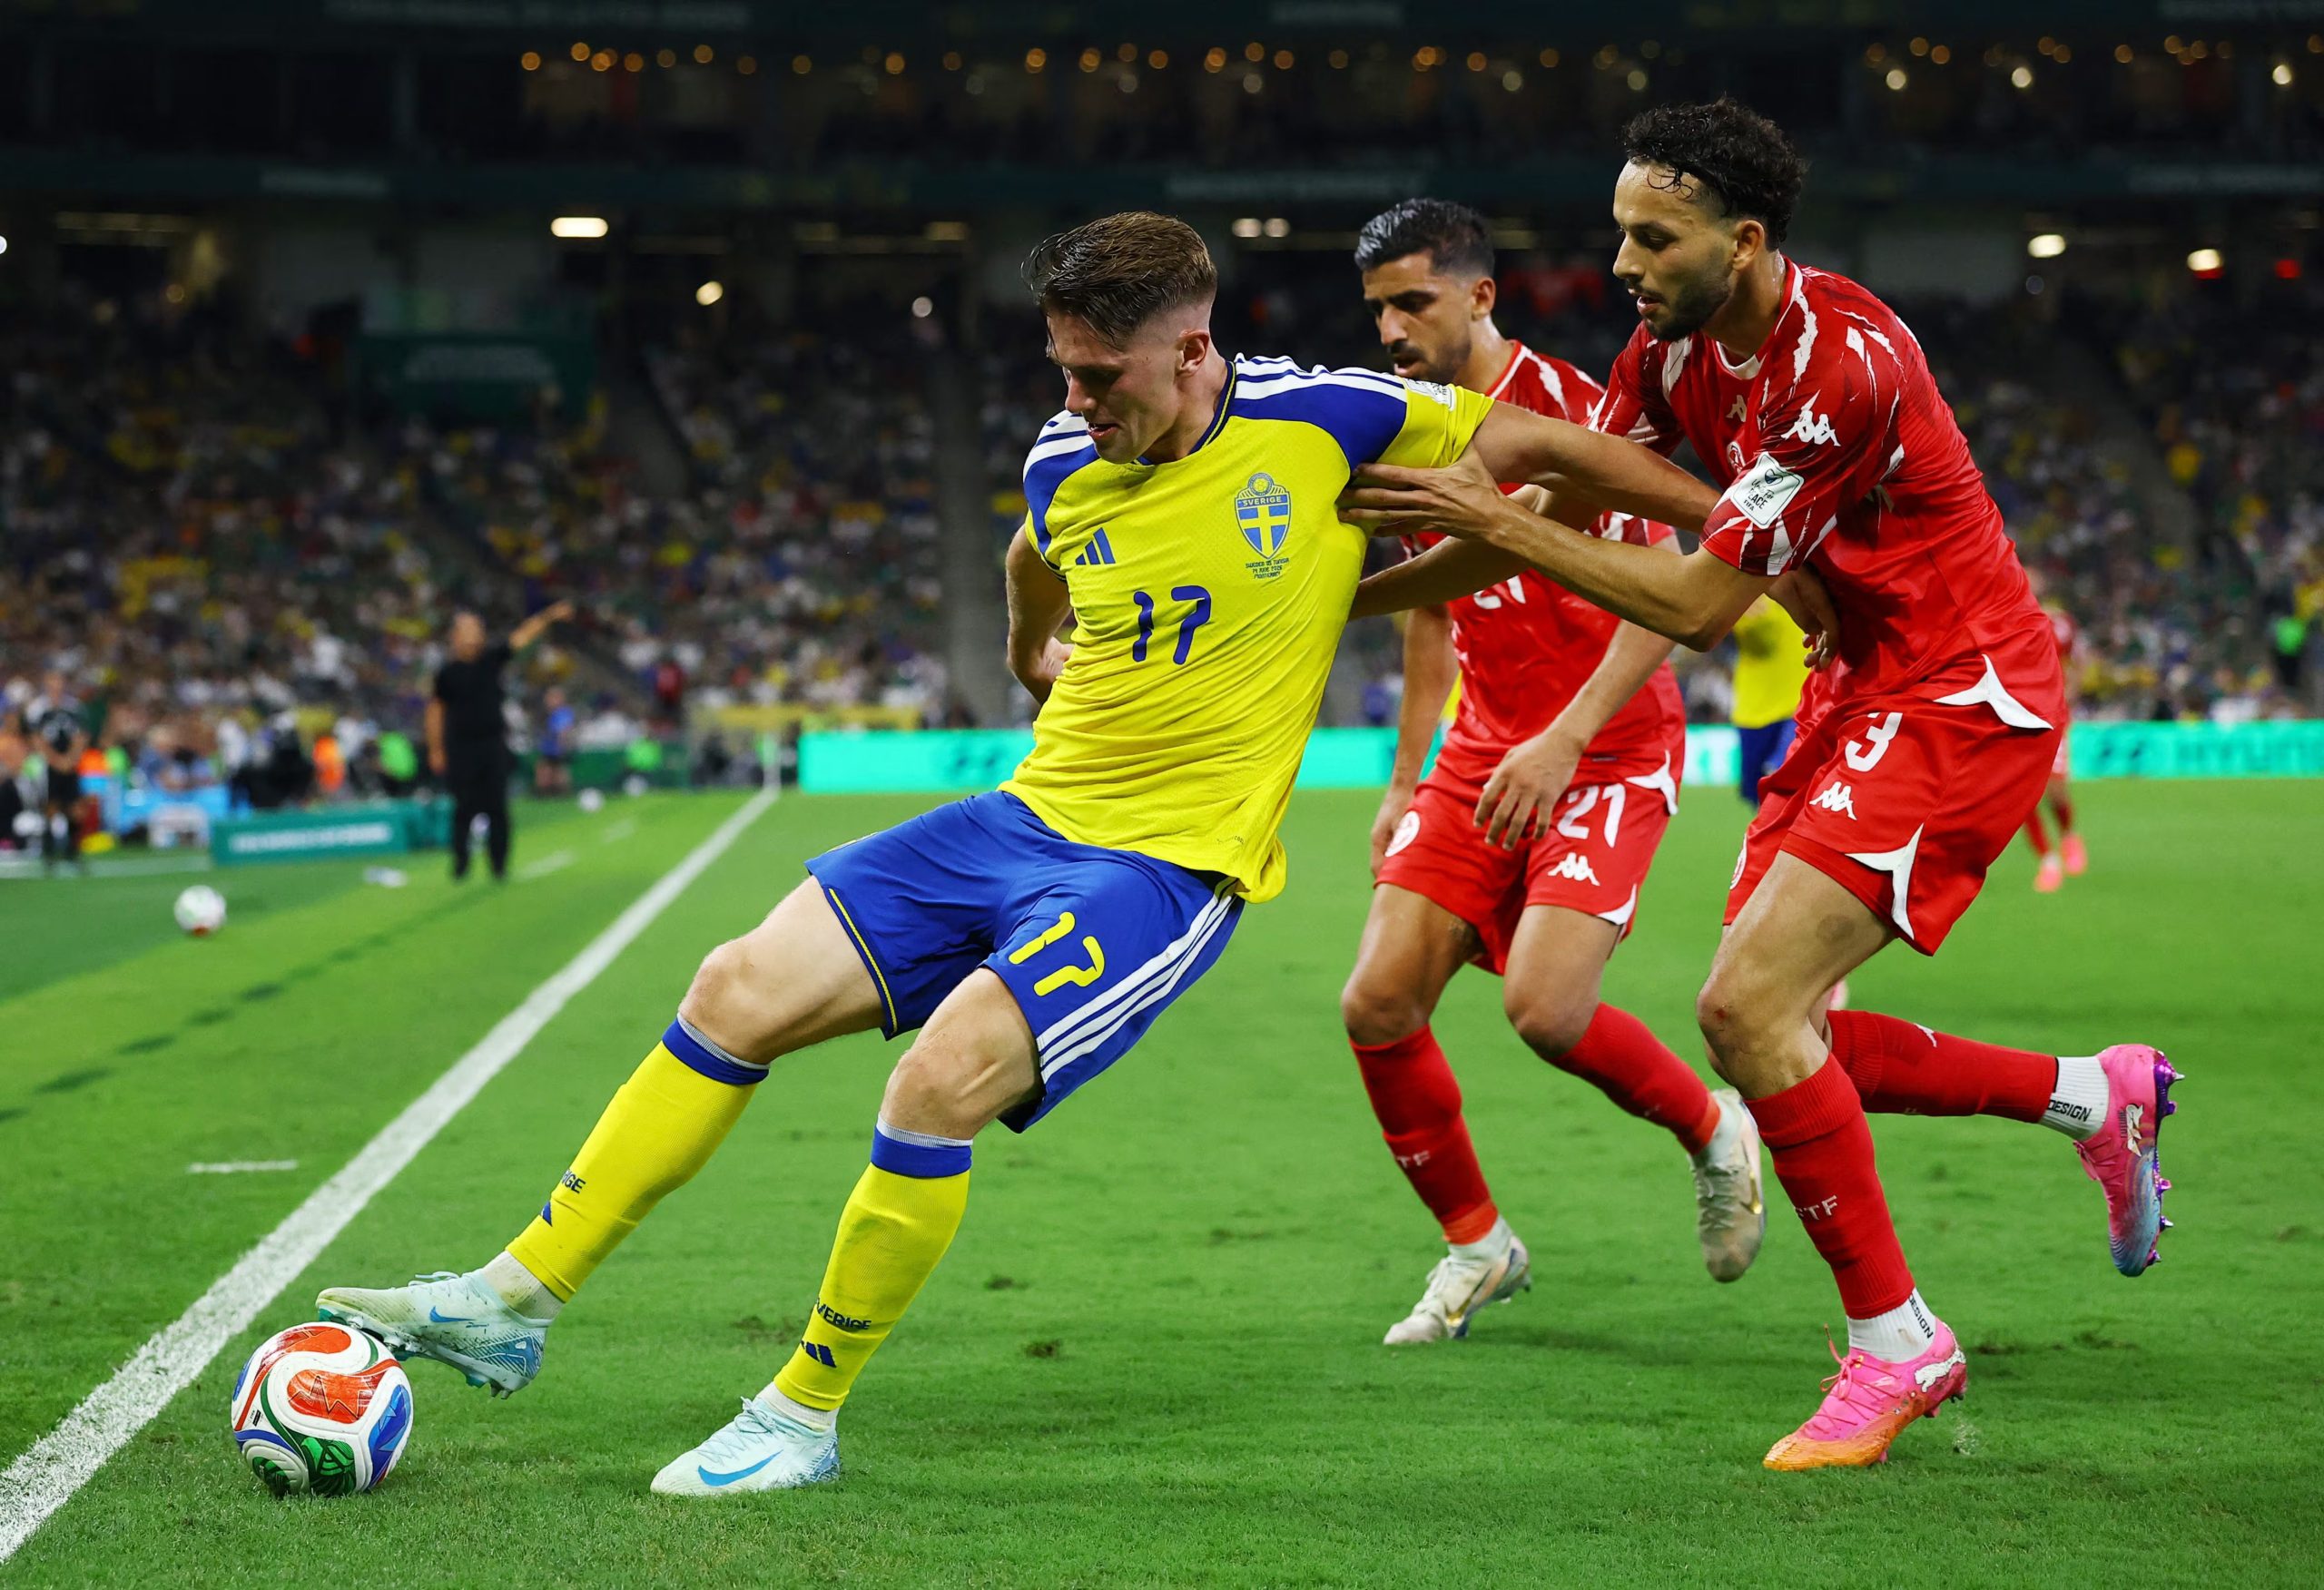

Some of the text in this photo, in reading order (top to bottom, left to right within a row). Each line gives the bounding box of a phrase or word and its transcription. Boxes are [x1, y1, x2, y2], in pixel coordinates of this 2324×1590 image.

[1243, 496, 1282, 506] SVERIGE
[1743, 499, 1754, 511] FIFA
[1132, 587, 1212, 666] 17
[1845, 712, 1904, 772] 3
[1557, 782, 1626, 849] 21
[1008, 911, 1106, 996] 17
[1396, 1150, 1431, 1169] TF
